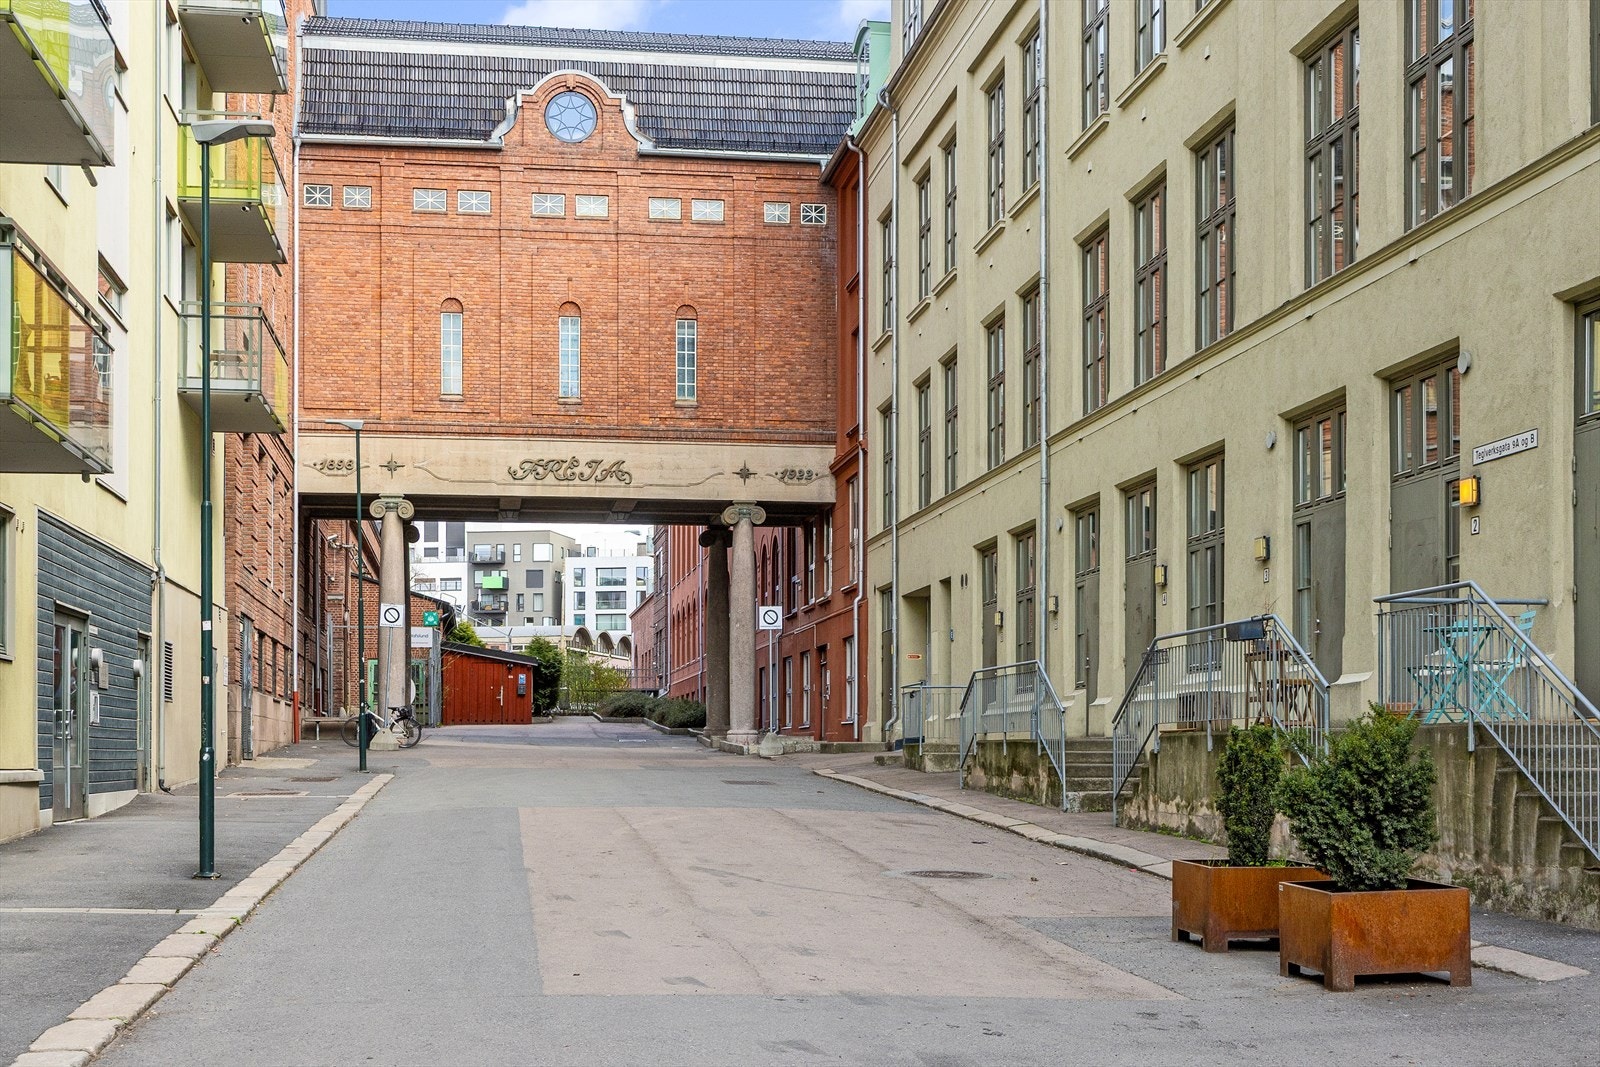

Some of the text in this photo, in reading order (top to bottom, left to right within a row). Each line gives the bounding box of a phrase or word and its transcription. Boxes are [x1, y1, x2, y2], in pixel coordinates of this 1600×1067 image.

[1475, 433, 1535, 461] Teglverksgata 9A og B
[780, 469, 813, 480] 1922
[1473, 519, 1478, 532] 2
